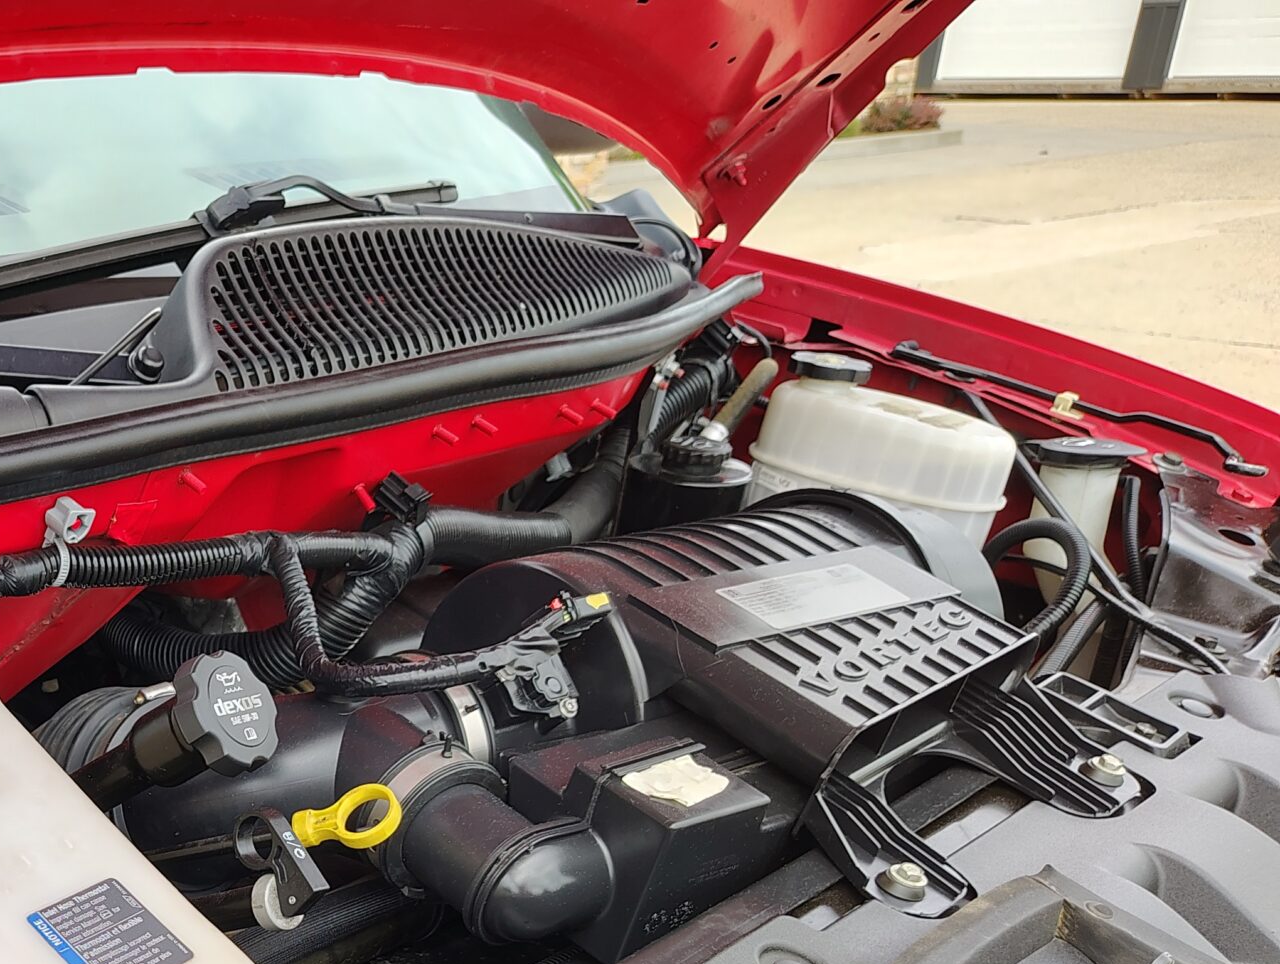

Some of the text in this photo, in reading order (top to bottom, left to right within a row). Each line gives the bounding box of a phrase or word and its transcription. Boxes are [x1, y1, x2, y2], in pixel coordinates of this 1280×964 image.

[799, 606, 972, 697] VORTEC
[213, 693, 262, 716] dexos
[74, 884, 111, 902] Thermostat
[33, 918, 63, 947] NOTICE
[76, 932, 114, 952] Thermostat
